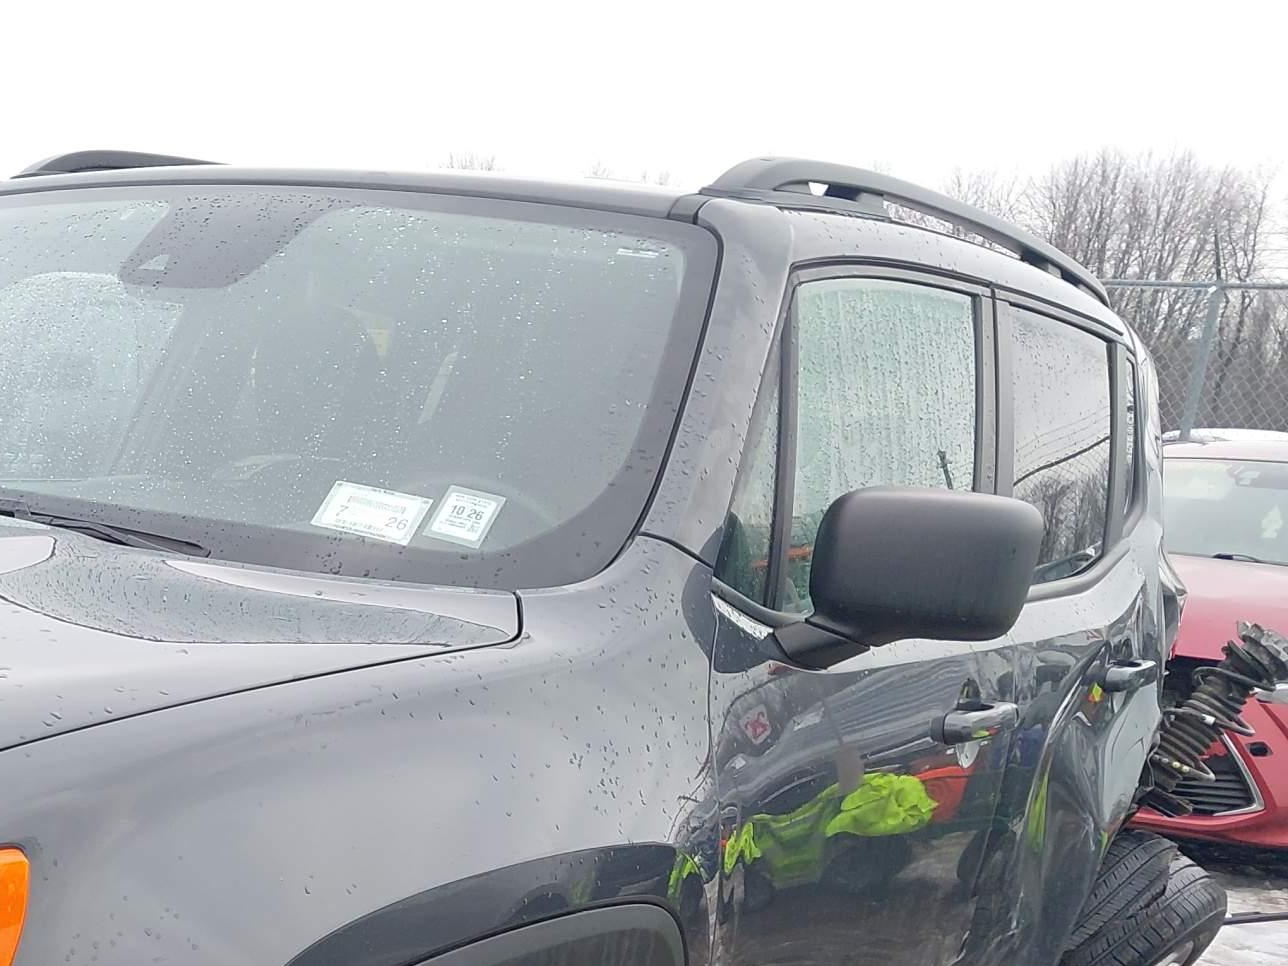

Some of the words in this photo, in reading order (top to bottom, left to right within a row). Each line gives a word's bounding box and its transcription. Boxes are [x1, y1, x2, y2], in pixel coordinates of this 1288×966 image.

[335, 504, 349, 517] 7
[384, 516, 409, 531] 26
[450, 504, 466, 516] 10
[466, 508, 485, 521] 26
